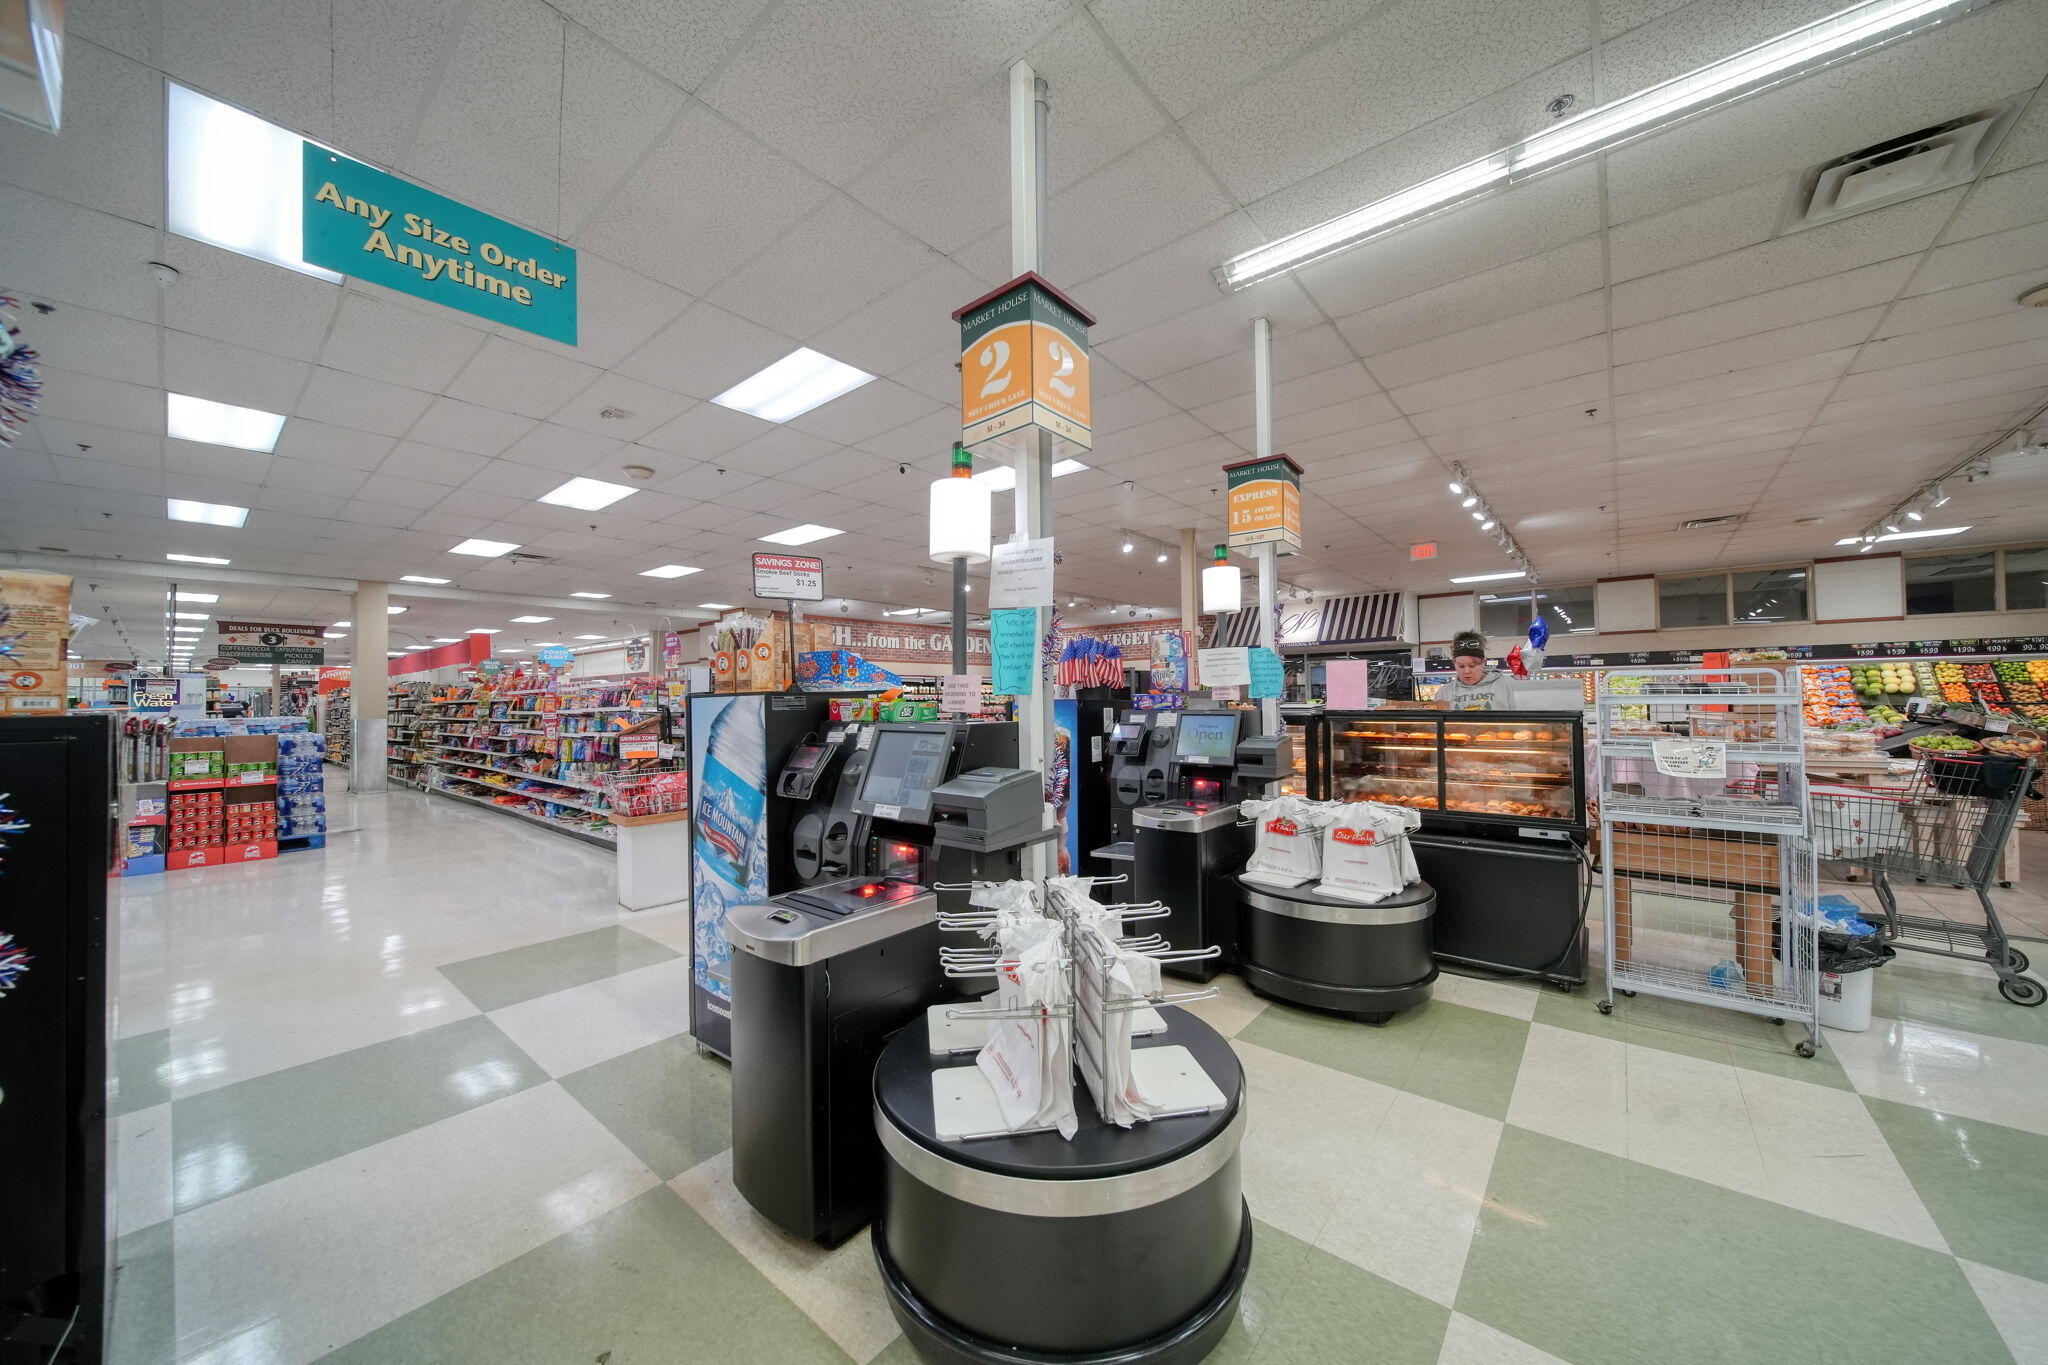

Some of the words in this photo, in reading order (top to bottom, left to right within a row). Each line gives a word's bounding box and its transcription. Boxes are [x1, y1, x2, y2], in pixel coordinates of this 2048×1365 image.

[314, 182, 392, 229] Any
[404, 213, 470, 255] Size
[480, 242, 568, 289] Order
[363, 230, 533, 306] Anytime
[963, 307, 996, 332] MARKET
[998, 292, 1028, 313] HOUSE
[1033, 292, 1062, 318] MARKET
[1064, 315, 1087, 336] HOUSE
[980, 340, 1012, 399] 2
[1048, 341, 1076, 398] 2
[1230, 468, 1255, 478] MARKET
[1258, 463, 1280, 473] HOUSE
[1234, 488, 1278, 504] EXPRESS
[1234, 508, 1252, 525] 15
[1254, 505, 1275, 514] ITEMS
[1412, 544, 1438, 559] EXIT
[756, 558, 792, 568] SAVINGS
[794, 560, 820, 570] ZONE!
[796, 578, 816, 586] $1.25
[268, 636, 277, 644] 3
[904, 636, 926, 650] the
[930, 634, 992, 654] GADEN
[134, 698, 178, 707] Water
[1470, 692, 1496, 701] LOST
[1188, 728, 1222, 744] Open
[702, 800, 712, 818] ICE
[712, 808, 746, 848] MOUNTAIN
[1336, 831, 1350, 839] Our
